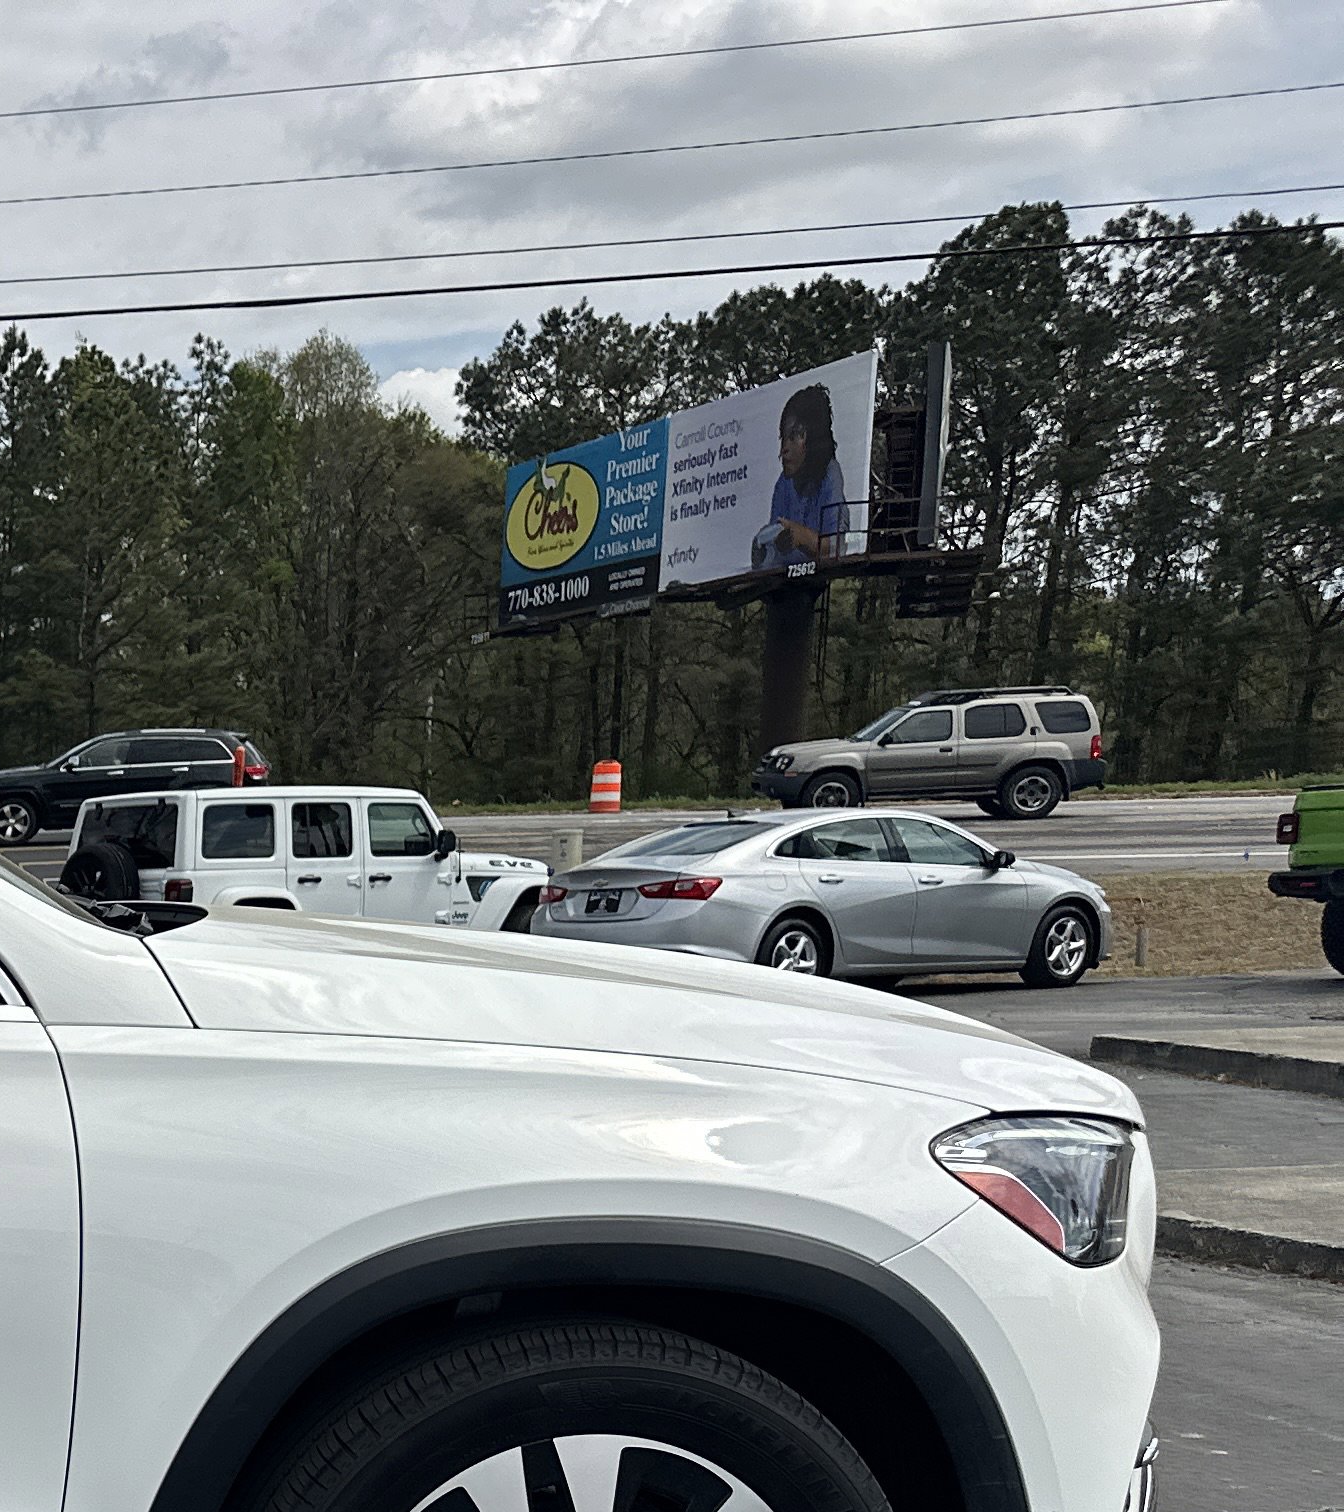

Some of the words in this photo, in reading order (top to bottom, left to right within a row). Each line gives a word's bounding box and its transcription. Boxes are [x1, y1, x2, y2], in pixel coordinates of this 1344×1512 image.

[618, 427, 650, 452] Your
[675, 425, 707, 450] Carroll
[607, 451, 660, 482] Premier
[673, 448, 717, 474] seriously
[718, 442, 738, 461] fast
[605, 481, 658, 508] Package
[672, 476, 704, 498] Xfinity
[706, 464, 748, 489] Internet
[610, 506, 649, 535] Store!
[670, 505, 678, 522] is
[680, 498, 712, 520] finally
[713, 494, 737, 511] here
[606, 540, 629, 558] Miles
[631, 532, 657, 551] Ahead
[667, 545, 699, 568] xfinity
[508, 575, 590, 611] 770-838-1000
